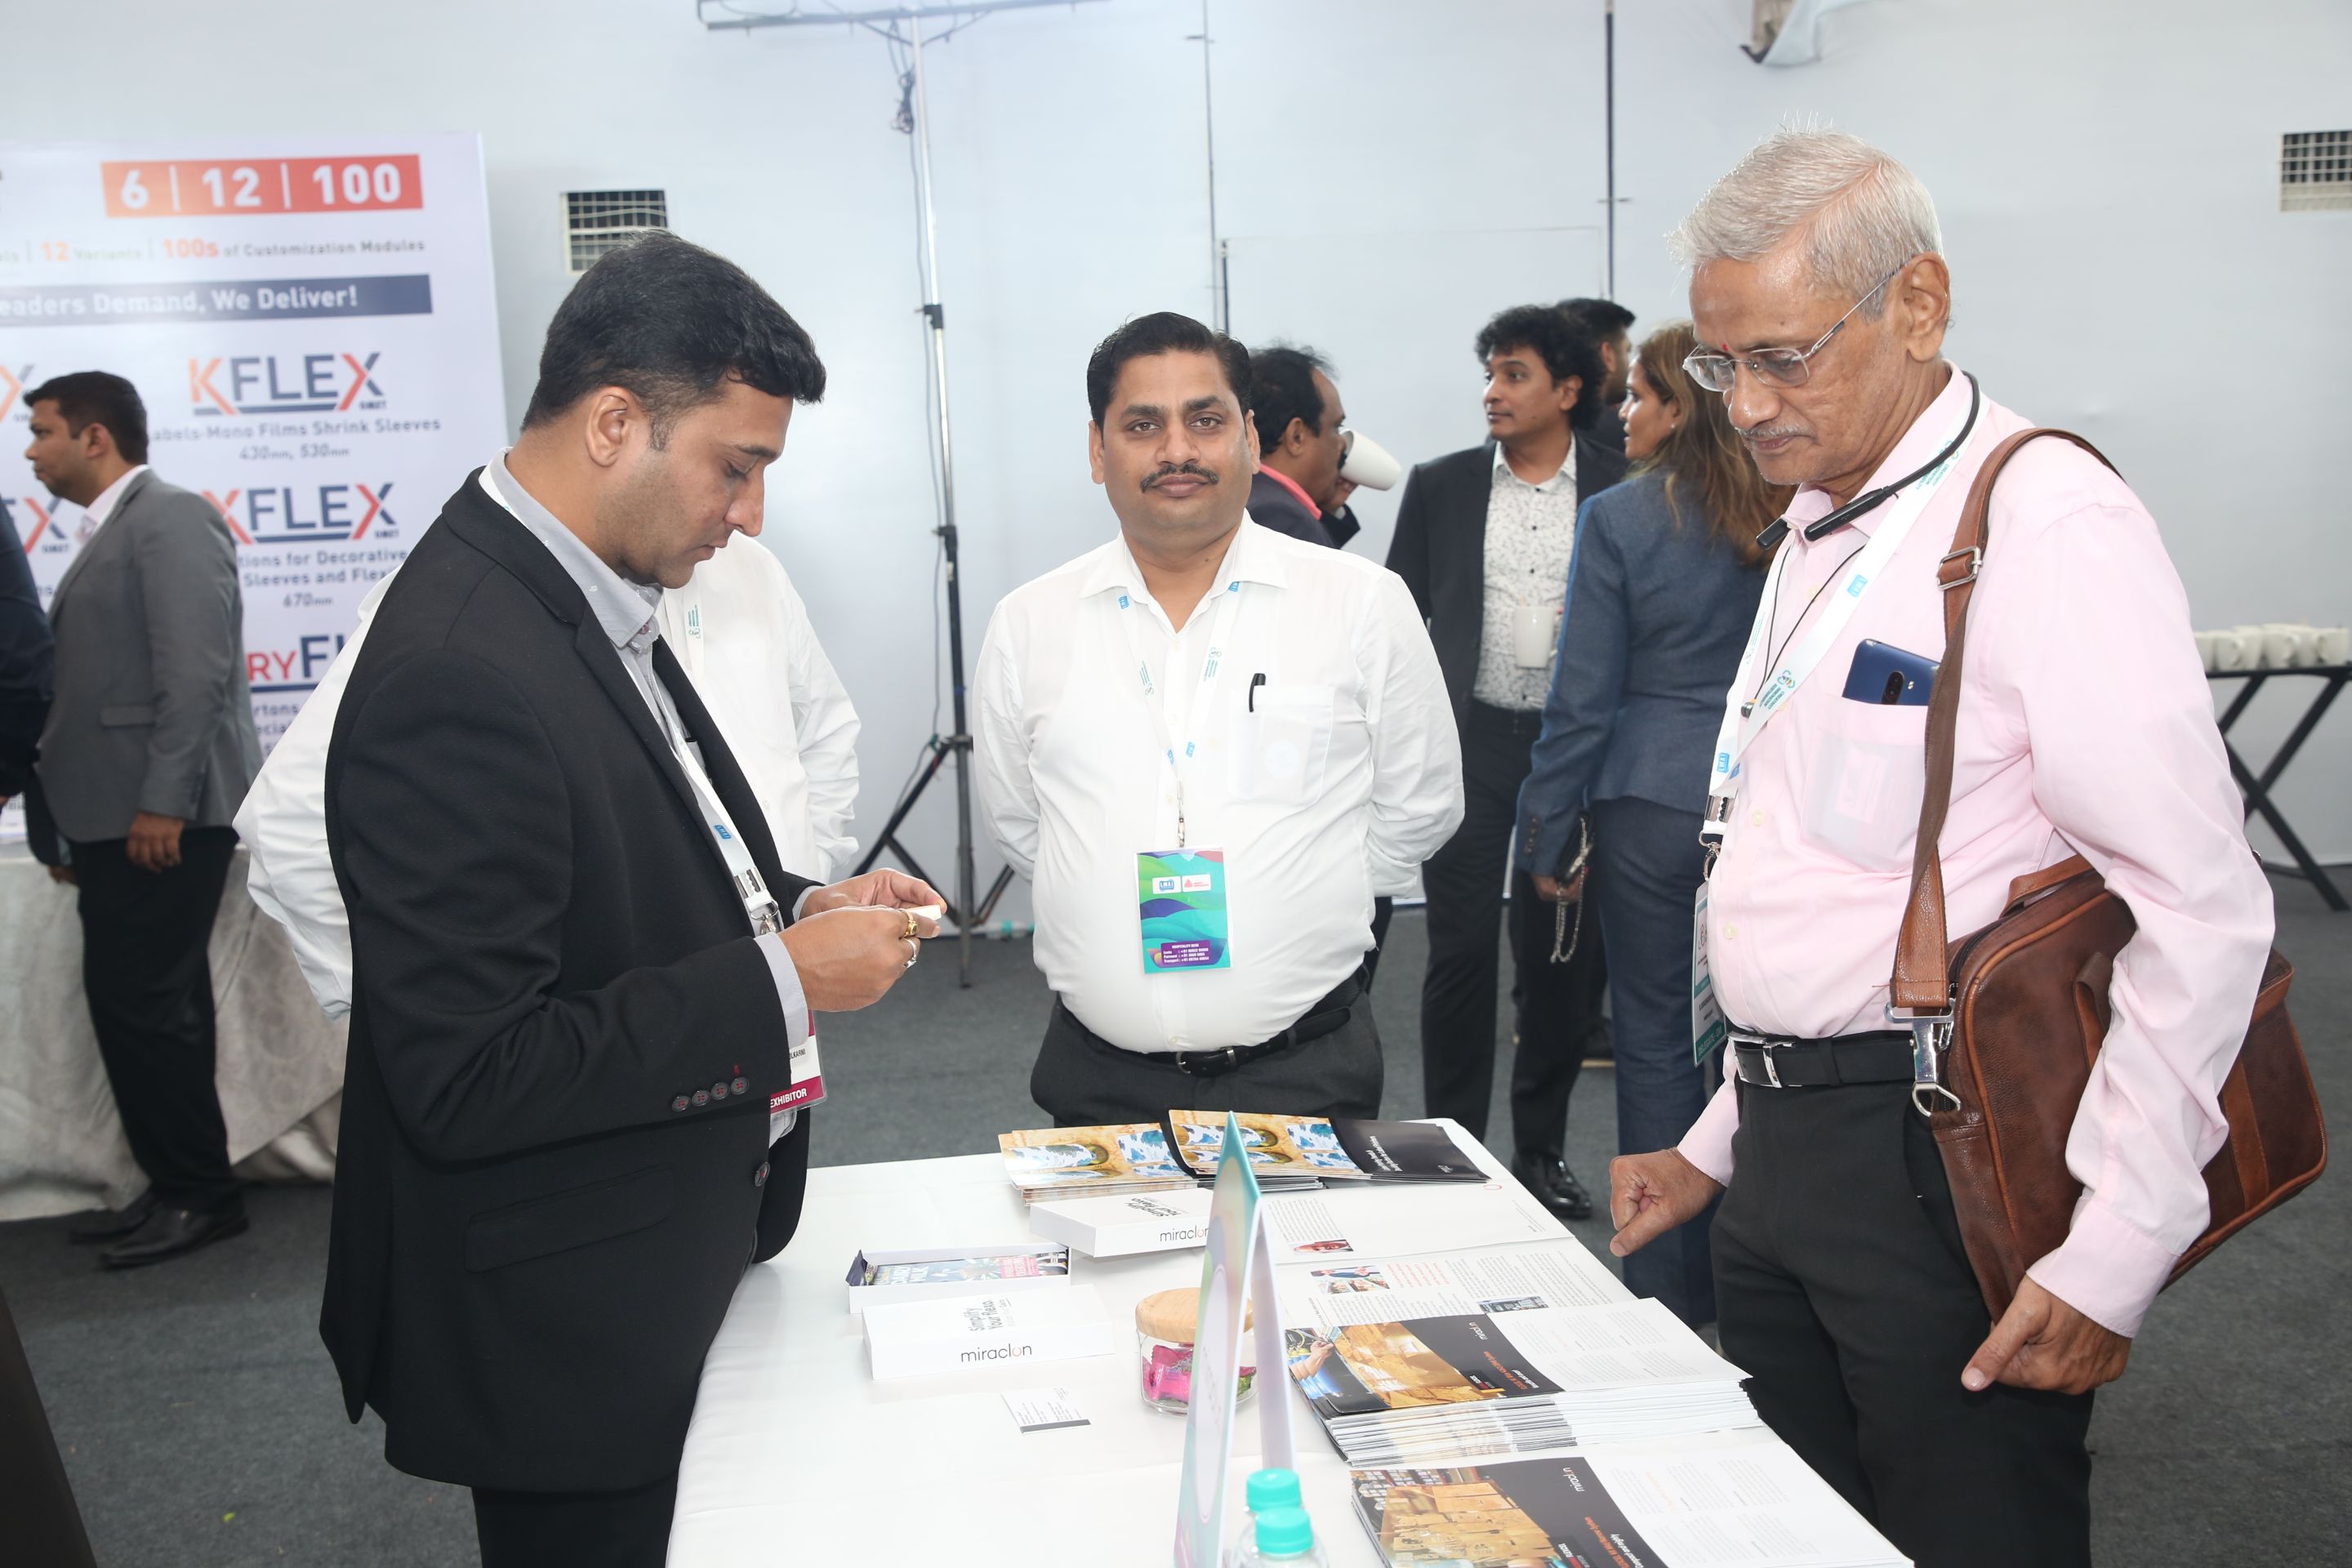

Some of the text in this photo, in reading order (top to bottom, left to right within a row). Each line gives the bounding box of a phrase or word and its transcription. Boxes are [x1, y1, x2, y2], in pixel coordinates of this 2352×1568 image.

[121, 163, 401, 210] 6 12 100
[41, 242, 70, 261] 12
[163, 239, 219, 259] 100s
[243, 242, 356, 258] Customization
[360, 238, 425, 253] Modules
[94, 288, 206, 314] Demand,
[212, 289, 251, 311] We
[257, 285, 358, 310] Deliver!
[188, 352, 384, 416] KFLEX
[150, 417, 441, 442] abels-Mono Films Shrink Sleeves
[287, 549, 310, 565] for
[317, 546, 407, 564] Decorative
[244, 571, 310, 588] Sleeves
[315, 568, 346, 585] and
[283, 592, 334, 608] 670mm
[770, 1088, 808, 1108] EXHIBITOR
[960, 1343, 1033, 1363] miraclon
